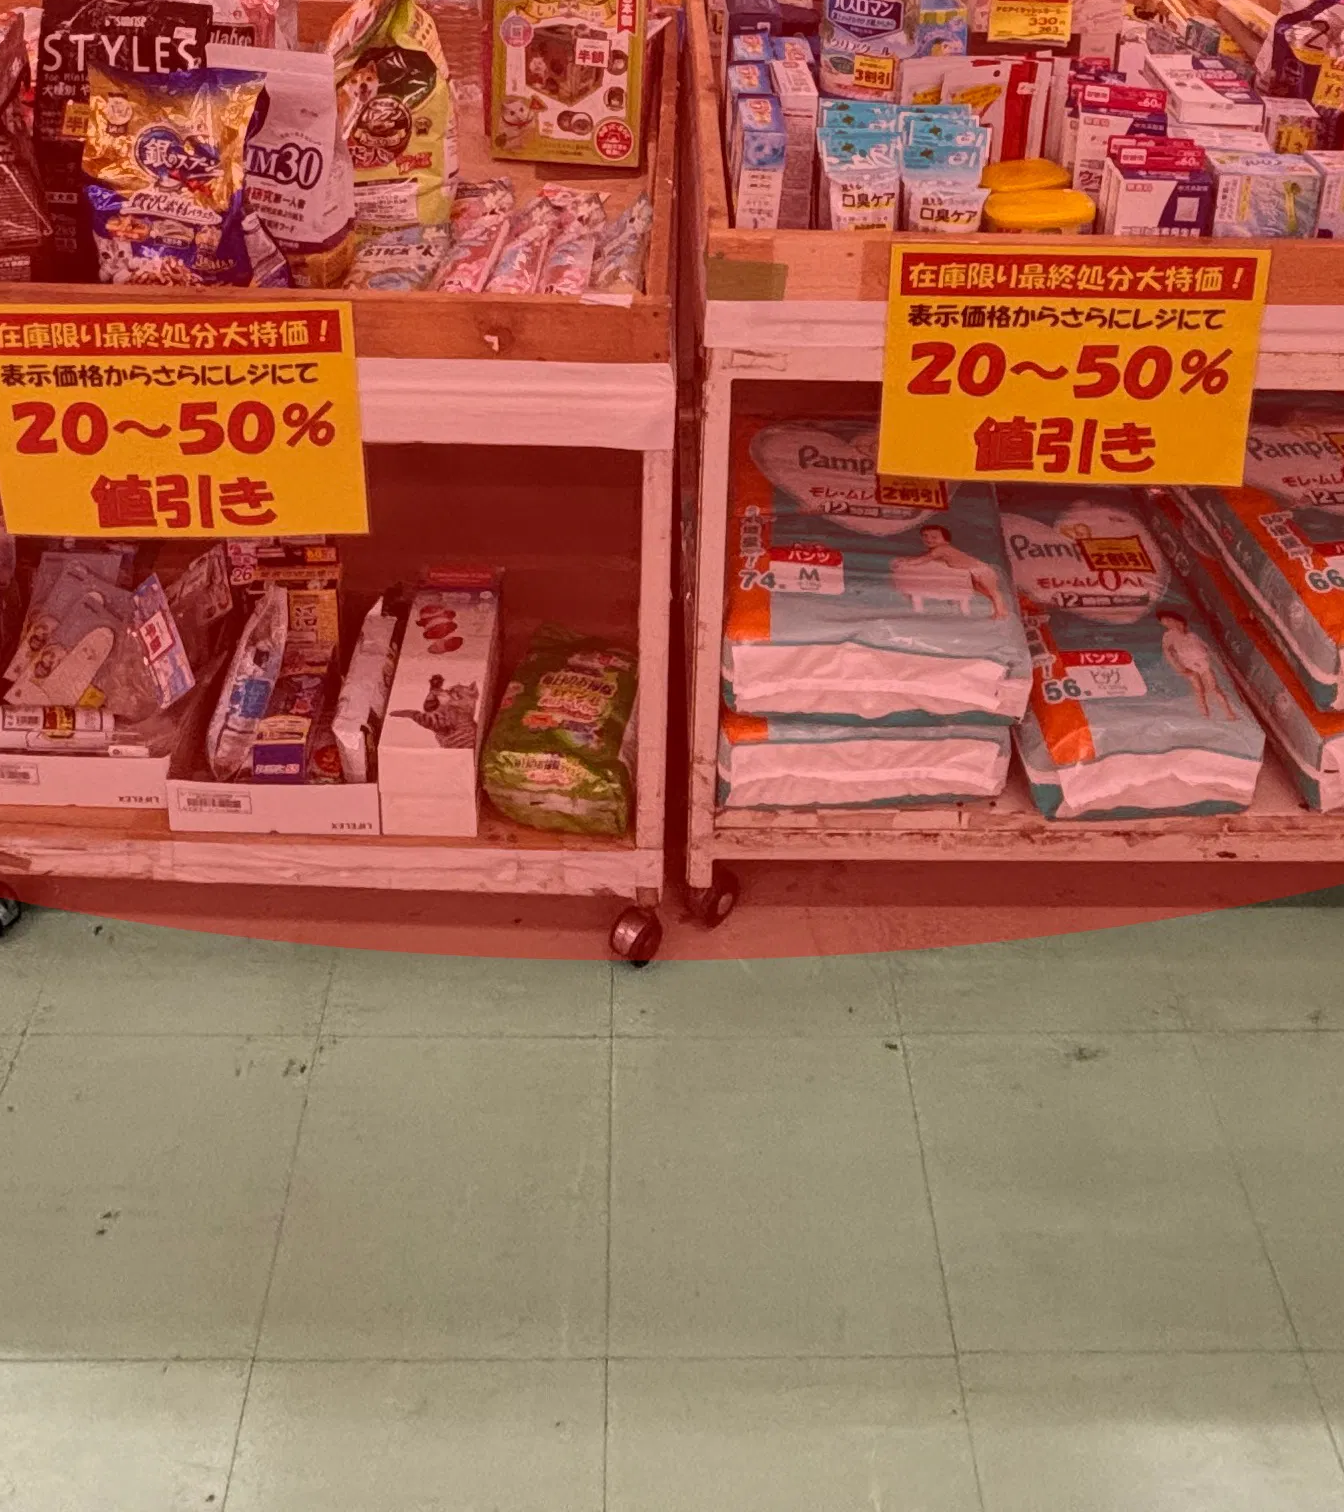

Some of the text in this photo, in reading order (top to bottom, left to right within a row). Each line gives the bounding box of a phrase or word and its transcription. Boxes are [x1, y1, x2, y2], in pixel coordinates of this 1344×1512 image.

[42, 32, 202, 74] STYLES
[842, 191, 895, 209] 口臭ケア
[920, 206, 978, 225] 口臭ケア
[908, 303, 1226, 332] 表示価格からさらにレジにて
[0, 361, 320, 387] 表示価格からさらにレジにて
[973, 415, 1157, 474] 値引き
[90, 473, 278, 530] 値引き
[788, 549, 830, 561] パンツ
[799, 567, 820, 582] M
[1080, 652, 1119, 664] パンツ
